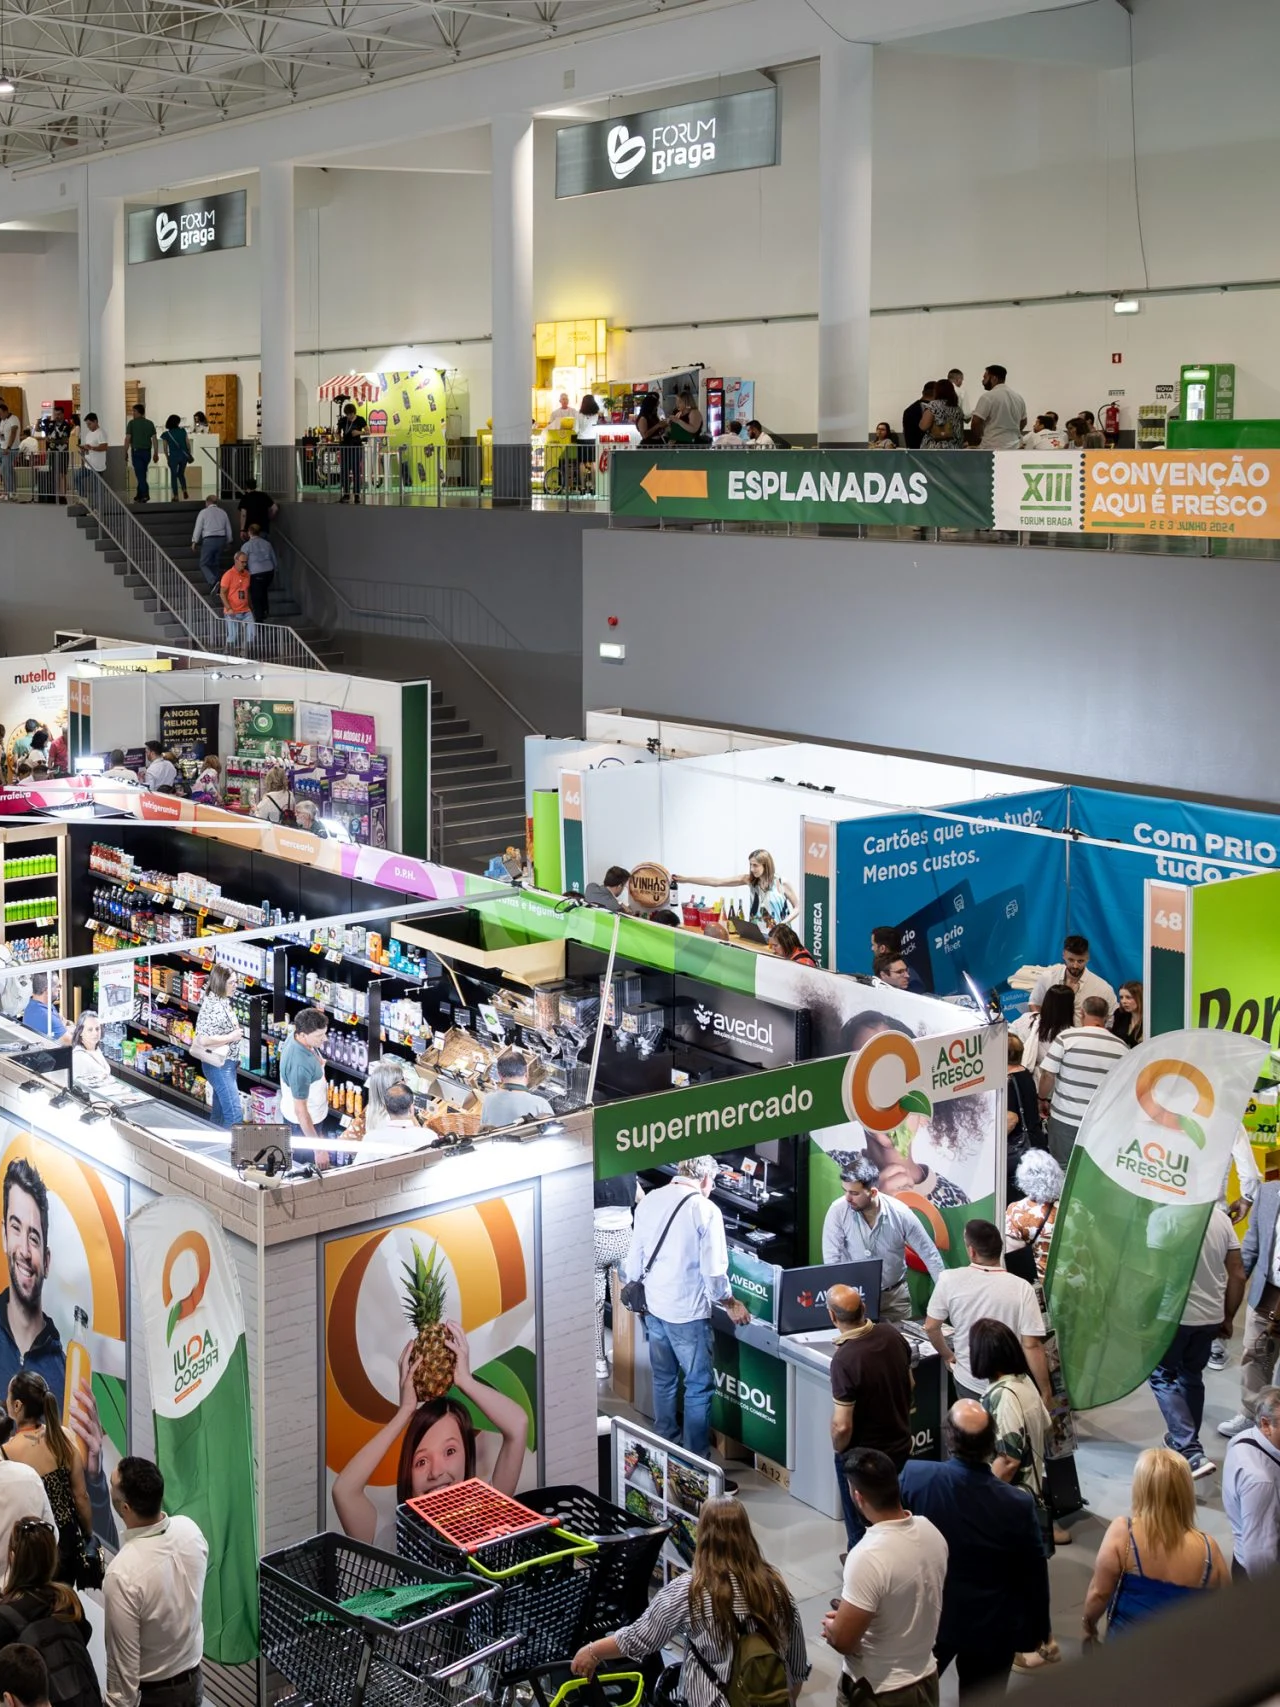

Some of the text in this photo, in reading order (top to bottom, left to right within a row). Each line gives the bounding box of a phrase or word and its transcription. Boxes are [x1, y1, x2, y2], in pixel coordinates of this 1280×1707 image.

[652, 118, 716, 149] FORUM
[652, 144, 716, 174] Braga
[181, 210, 215, 231] FORUM
[181, 228, 215, 250] Braga
[1091, 455, 1270, 494] CONVENÇÃO
[728, 470, 928, 504] ESPLANADAS
[1021, 472, 1072, 502] XIII
[1091, 488, 1268, 517] AQUI É FRESCO
[1020, 516, 1073, 527] FORUM BRAGA
[1150, 521, 1157, 530] 2
[1167, 521, 1174, 530] 3
[1177, 521, 1207, 531] JUNHO
[1209, 522, 1236, 533] 2024
[14, 668, 57, 684] nutella
[31, 682, 56, 693] biscuits
[163, 709, 200, 718] A NOSSA
[164, 718, 198, 727] MELHOR
[164, 728, 200, 737] LIMPEZA
[141, 799, 179, 817] refrigerantes
[565, 791, 580, 805] 46
[863, 829, 928, 856] Cartões
[933, 822, 964, 846] que
[1004, 807, 1044, 827] tudo.
[1133, 822, 1277, 865] Com PRIO
[279, 837, 314, 854] mercearia
[808, 842, 827, 859] 47
[394, 867, 417, 881] D.P.H.
[863, 849, 980, 885] Menos custos.
[1156, 855, 1222, 883] tudo
[528, 902, 565, 921] legumes
[1154, 910, 1182, 931] 48
[813, 902, 823, 956] FONSECA
[901, 928, 916, 946] rio
[943, 924, 964, 945] prio
[944, 940, 961, 955] fleet
[713, 1012, 774, 1046] avedol
[937, 1034, 982, 1070] AQUI
[932, 1058, 984, 1090] FRESCO
[615, 1085, 813, 1152] supermercado
[1125, 1138, 1190, 1174] AQUI
[1116, 1154, 1187, 1188] FRESCO
[730, 1273, 768, 1299] AVEDOL
[713, 1367, 776, 1415] VEDOL
